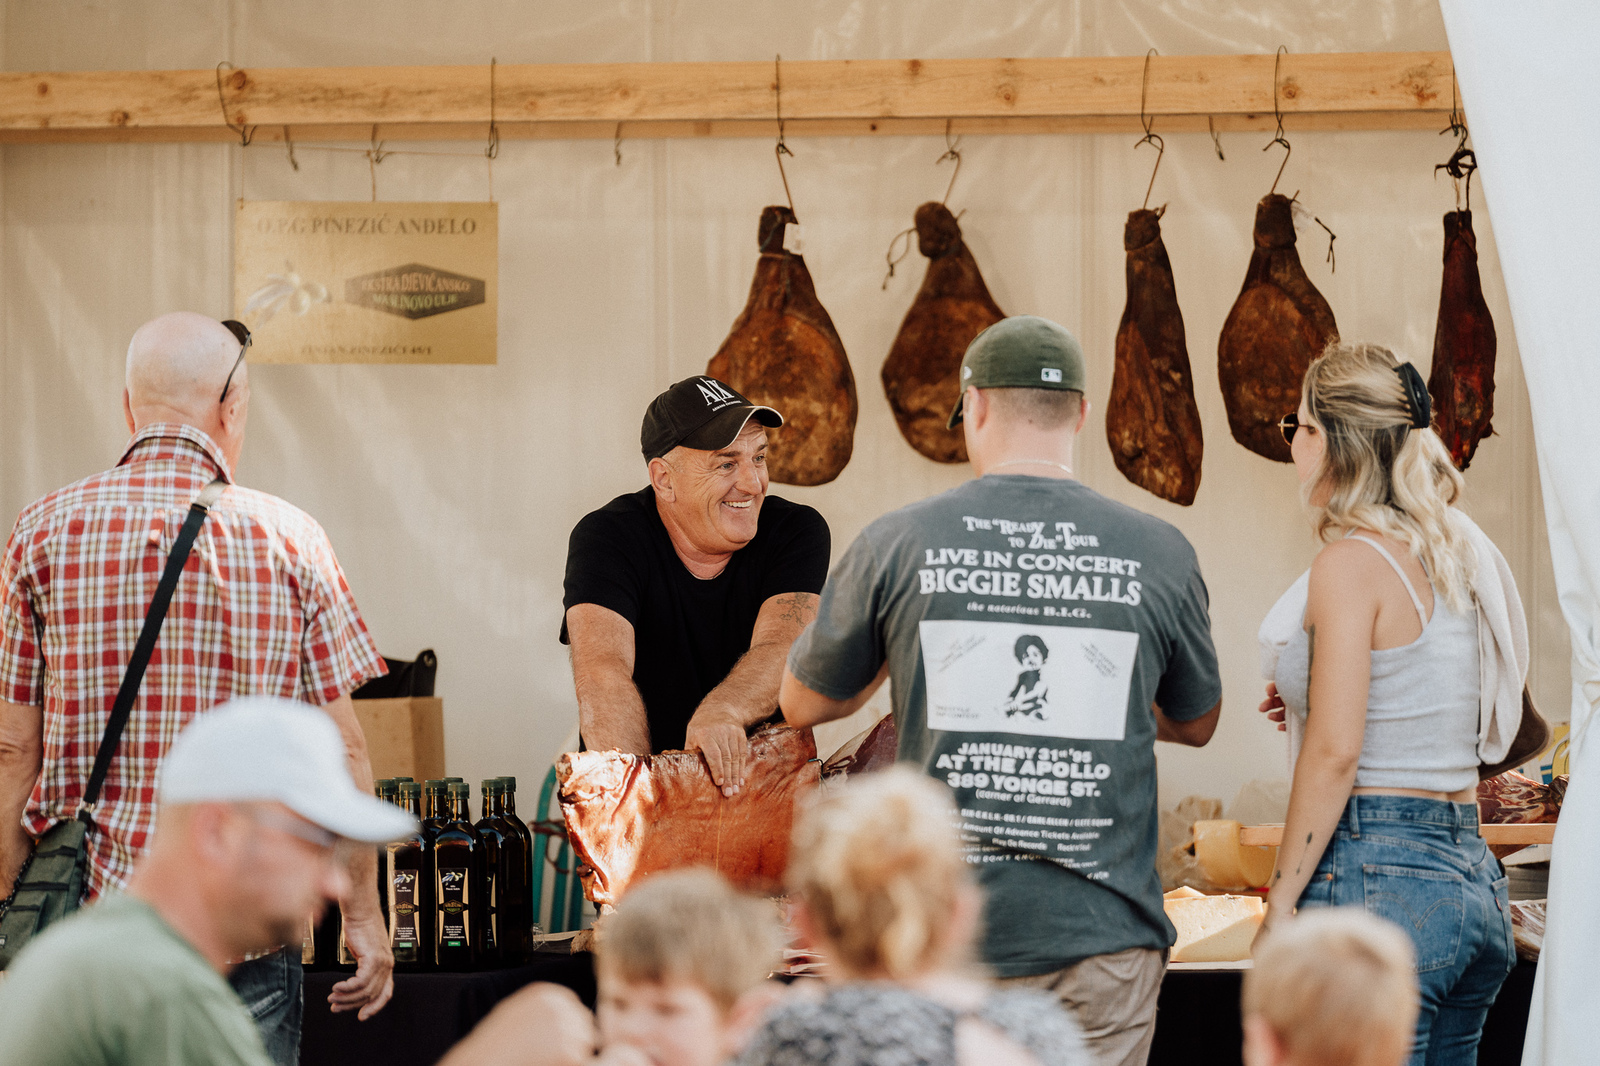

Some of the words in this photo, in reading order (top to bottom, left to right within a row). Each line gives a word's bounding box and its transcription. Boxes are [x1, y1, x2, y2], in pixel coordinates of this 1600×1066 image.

[310, 212, 390, 236] PINEZIĆ
[1007, 536, 1026, 549] TO
[1054, 521, 1100, 551] TOUR
[924, 548, 980, 567] LIVE
[982, 550, 1014, 569] IN
[1016, 553, 1142, 577] CONCERT
[917, 567, 1022, 597] BIGGIE
[1026, 573, 1143, 606] SMALLS
[966, 600, 984, 613] the
[987, 603, 1040, 616] notorious
[1042, 605, 1093, 619] B.I.G.
[957, 742, 1037, 760] JANUARY
[935, 754, 967, 771] AT
[969, 755, 1017, 775] THE
[1019, 760, 1112, 780] APOLLO
[946, 772, 990, 788] 389
[991, 774, 1069, 797] YONGE
[1070, 781, 1102, 798] ST.
[975, 788, 1012, 802] (corner
[1013, 793, 1027, 803] of
[1027, 794, 1073, 809] Gerrard)
[962, 822, 994, 834] Amount
[994, 826, 1006, 835] Of
[1005, 826, 1040, 838] Advance
[1040, 830, 1070, 841] Tickets
